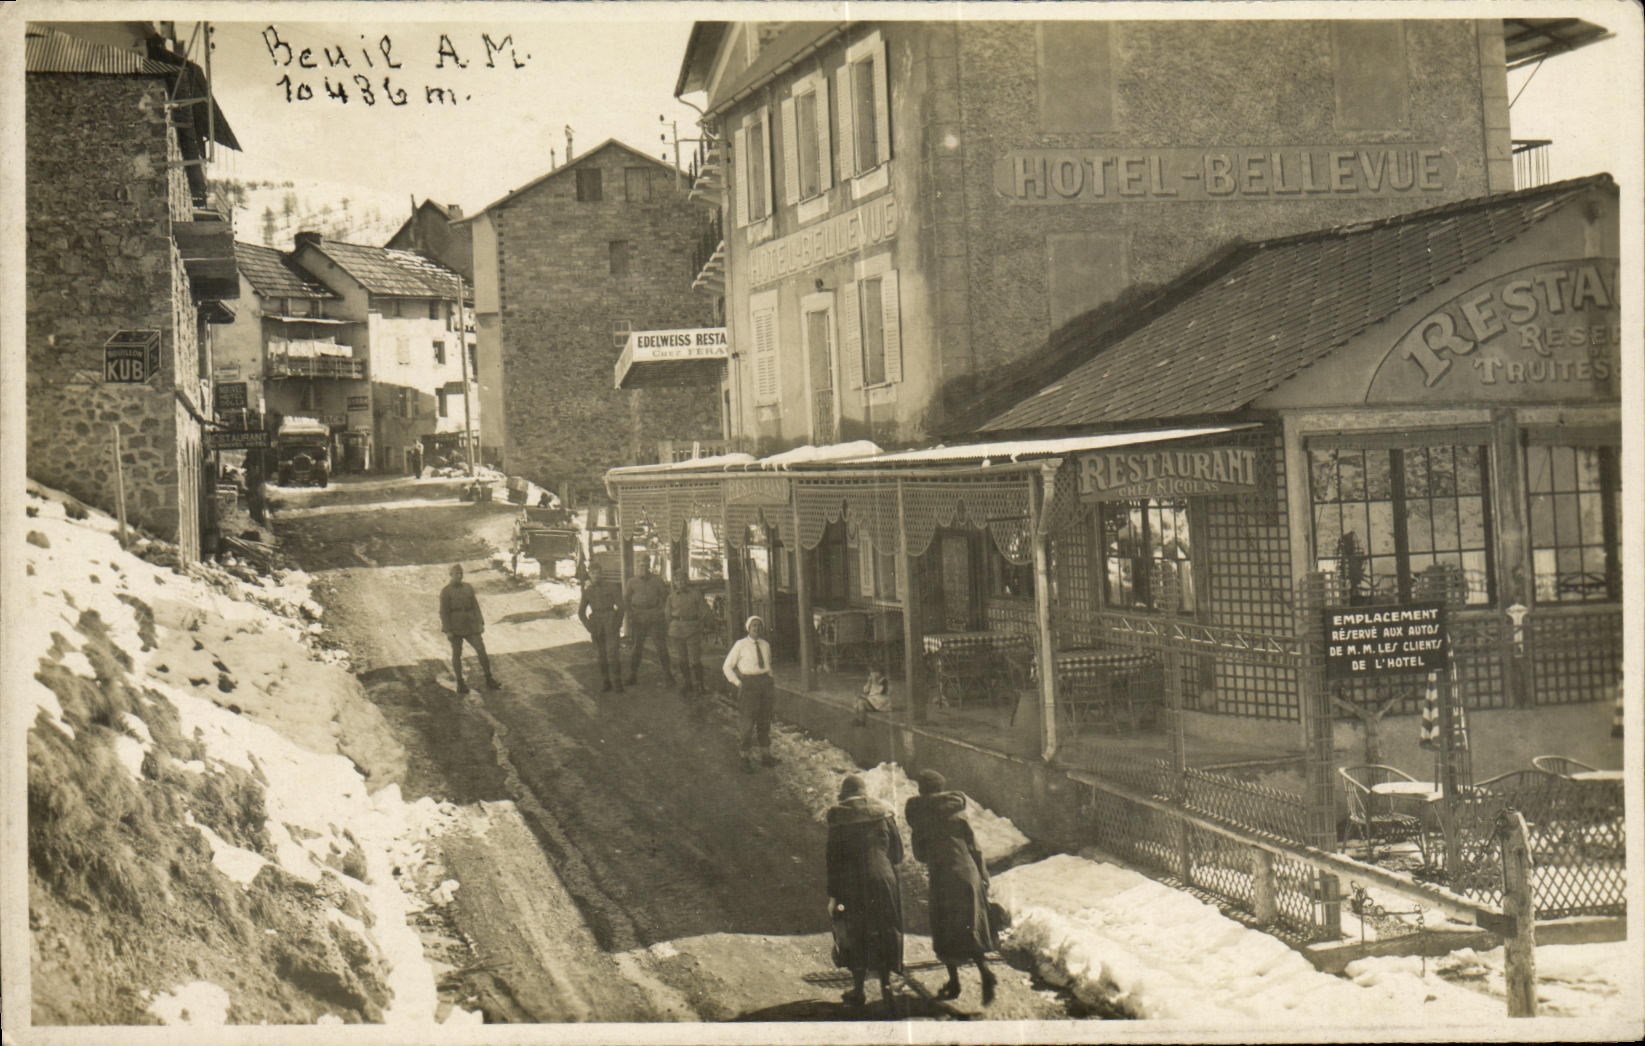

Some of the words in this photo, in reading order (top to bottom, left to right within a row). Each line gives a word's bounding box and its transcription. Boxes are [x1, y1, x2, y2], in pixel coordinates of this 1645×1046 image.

[262, 25, 401, 69] Beuil
[1403, 264, 1621, 388] RESTA
[637, 334, 692, 349] EDELWEISS
[107, 359, 144, 381] KUB
[1473, 356, 1611, 385] TRUITES
[1079, 449, 1257, 494] RESTAURANT
[1118, 485, 1150, 497] CHEZ
[1155, 477, 1221, 495] NICOLAS
[1332, 608, 1439, 626] EMPLACEMENT
[1331, 626, 1378, 641] RÉSERVÉ
[1383, 626, 1404, 638] AUX
[1408, 623, 1440, 637] AUTOS
[1329, 645, 1343, 657] DE
[1377, 641, 1399, 653] LES
[1402, 638, 1443, 652] CLIENTS
[1351, 659, 1367, 671] DE
[1375, 655, 1425, 669] L'HOTEL
